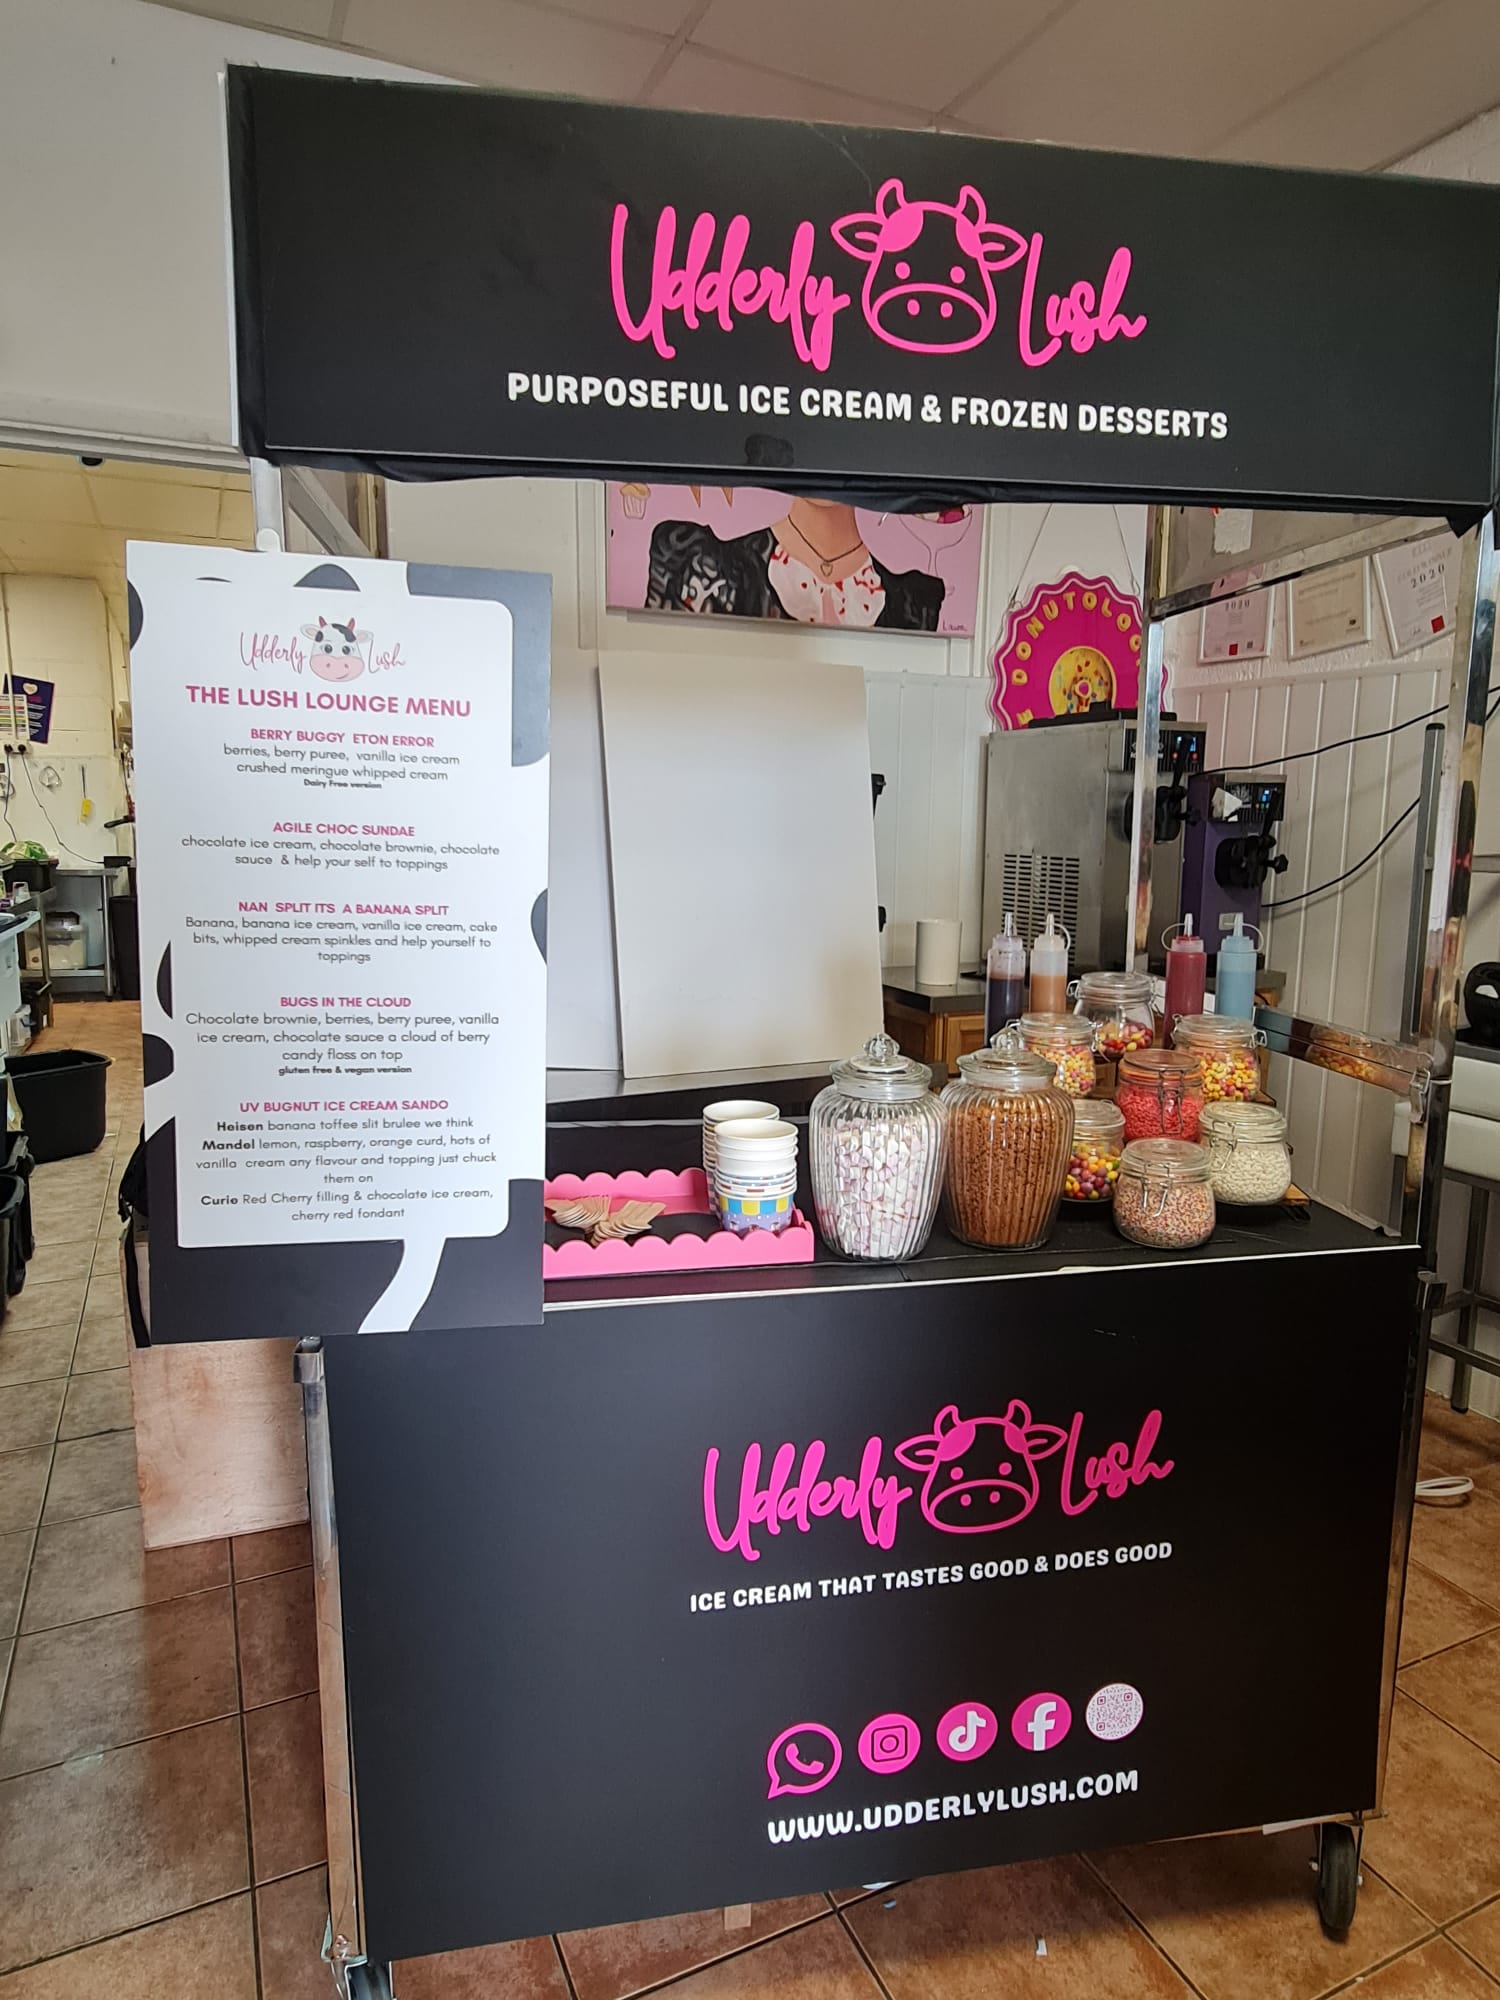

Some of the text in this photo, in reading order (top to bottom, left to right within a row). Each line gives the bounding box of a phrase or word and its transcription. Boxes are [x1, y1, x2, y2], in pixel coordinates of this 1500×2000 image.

[610, 202, 1148, 372] Udderly Lush
[507, 371, 1229, 440] PURPOSEFUL ICE CREAM & FROZEN DESSERTS
[1410, 563, 1445, 588] 2020
[240, 632, 406, 673] Udderly Lush
[185, 685, 471, 717] THE LUSH LOUNGE MENU
[250, 728, 434, 748] BERRY BUGGY ETON ERROR
[223, 743, 460, 765] berries, berry puree, vanilla ice cream
[236, 760, 448, 781] crushed meringue whipped cream
[303, 778, 382, 789] Dairy Free version
[273, 822, 415, 836] AGILE CHOC SUNDAE
[181, 835, 500, 855] chocolate ice cream, chocolate brownie, chocolate
[235, 854, 448, 872] sauce & help your self to toppings
[238, 902, 268, 912] NAN
[275, 902, 311, 912] SPLIT
[342, 904, 353, 914] A
[356, 904, 411, 915] BANANA
[415, 905, 449, 915] SPLIT
[185, 916, 498, 932] Banana, banana ice cream, vanilla ice cream, cake
[193, 932, 491, 949] bits, whipped cream spinkles and help yourself to
[318, 952, 371, 964] toppings
[280, 997, 411, 1007] BUGS IN THE CLOUD
[186, 1012, 499, 1027] Chocolate brownie, berries, berry puree, vanilla
[197, 1030, 490, 1045] ice cream, chocolate sauce a cloud of berry
[282, 1048, 403, 1063] candy floss on top
[278, 1066, 310, 1076] gluten
[344, 1066, 375, 1075] vegan
[377, 1065, 412, 1073] version
[240, 1100, 449, 1112] UV BUGNUT ICE CREAM SANDO
[217, 1116, 474, 1131] Heisen banana toffee slit brulee we think
[202, 1134, 491, 1150] Mandel lemon, raspberry, orange curd, hots of
[196, 1152, 497, 1169] vanilla cream any flavour and topping just chuck
[324, 1173, 373, 1183] them on
[200, 1189, 493, 1205] Curie Red Cherry filling & chocolate ice cream,
[291, 1208, 405, 1223] cherry red fondant
[703, 1409, 1175, 1561] Udderly Lush
[689, 1541, 1173, 1612] ICE CREAM THAT TASTES GOOD & DOES GOOD
[767, 1768, 1140, 1844] WWW.UDDERLYLUSH.COM
